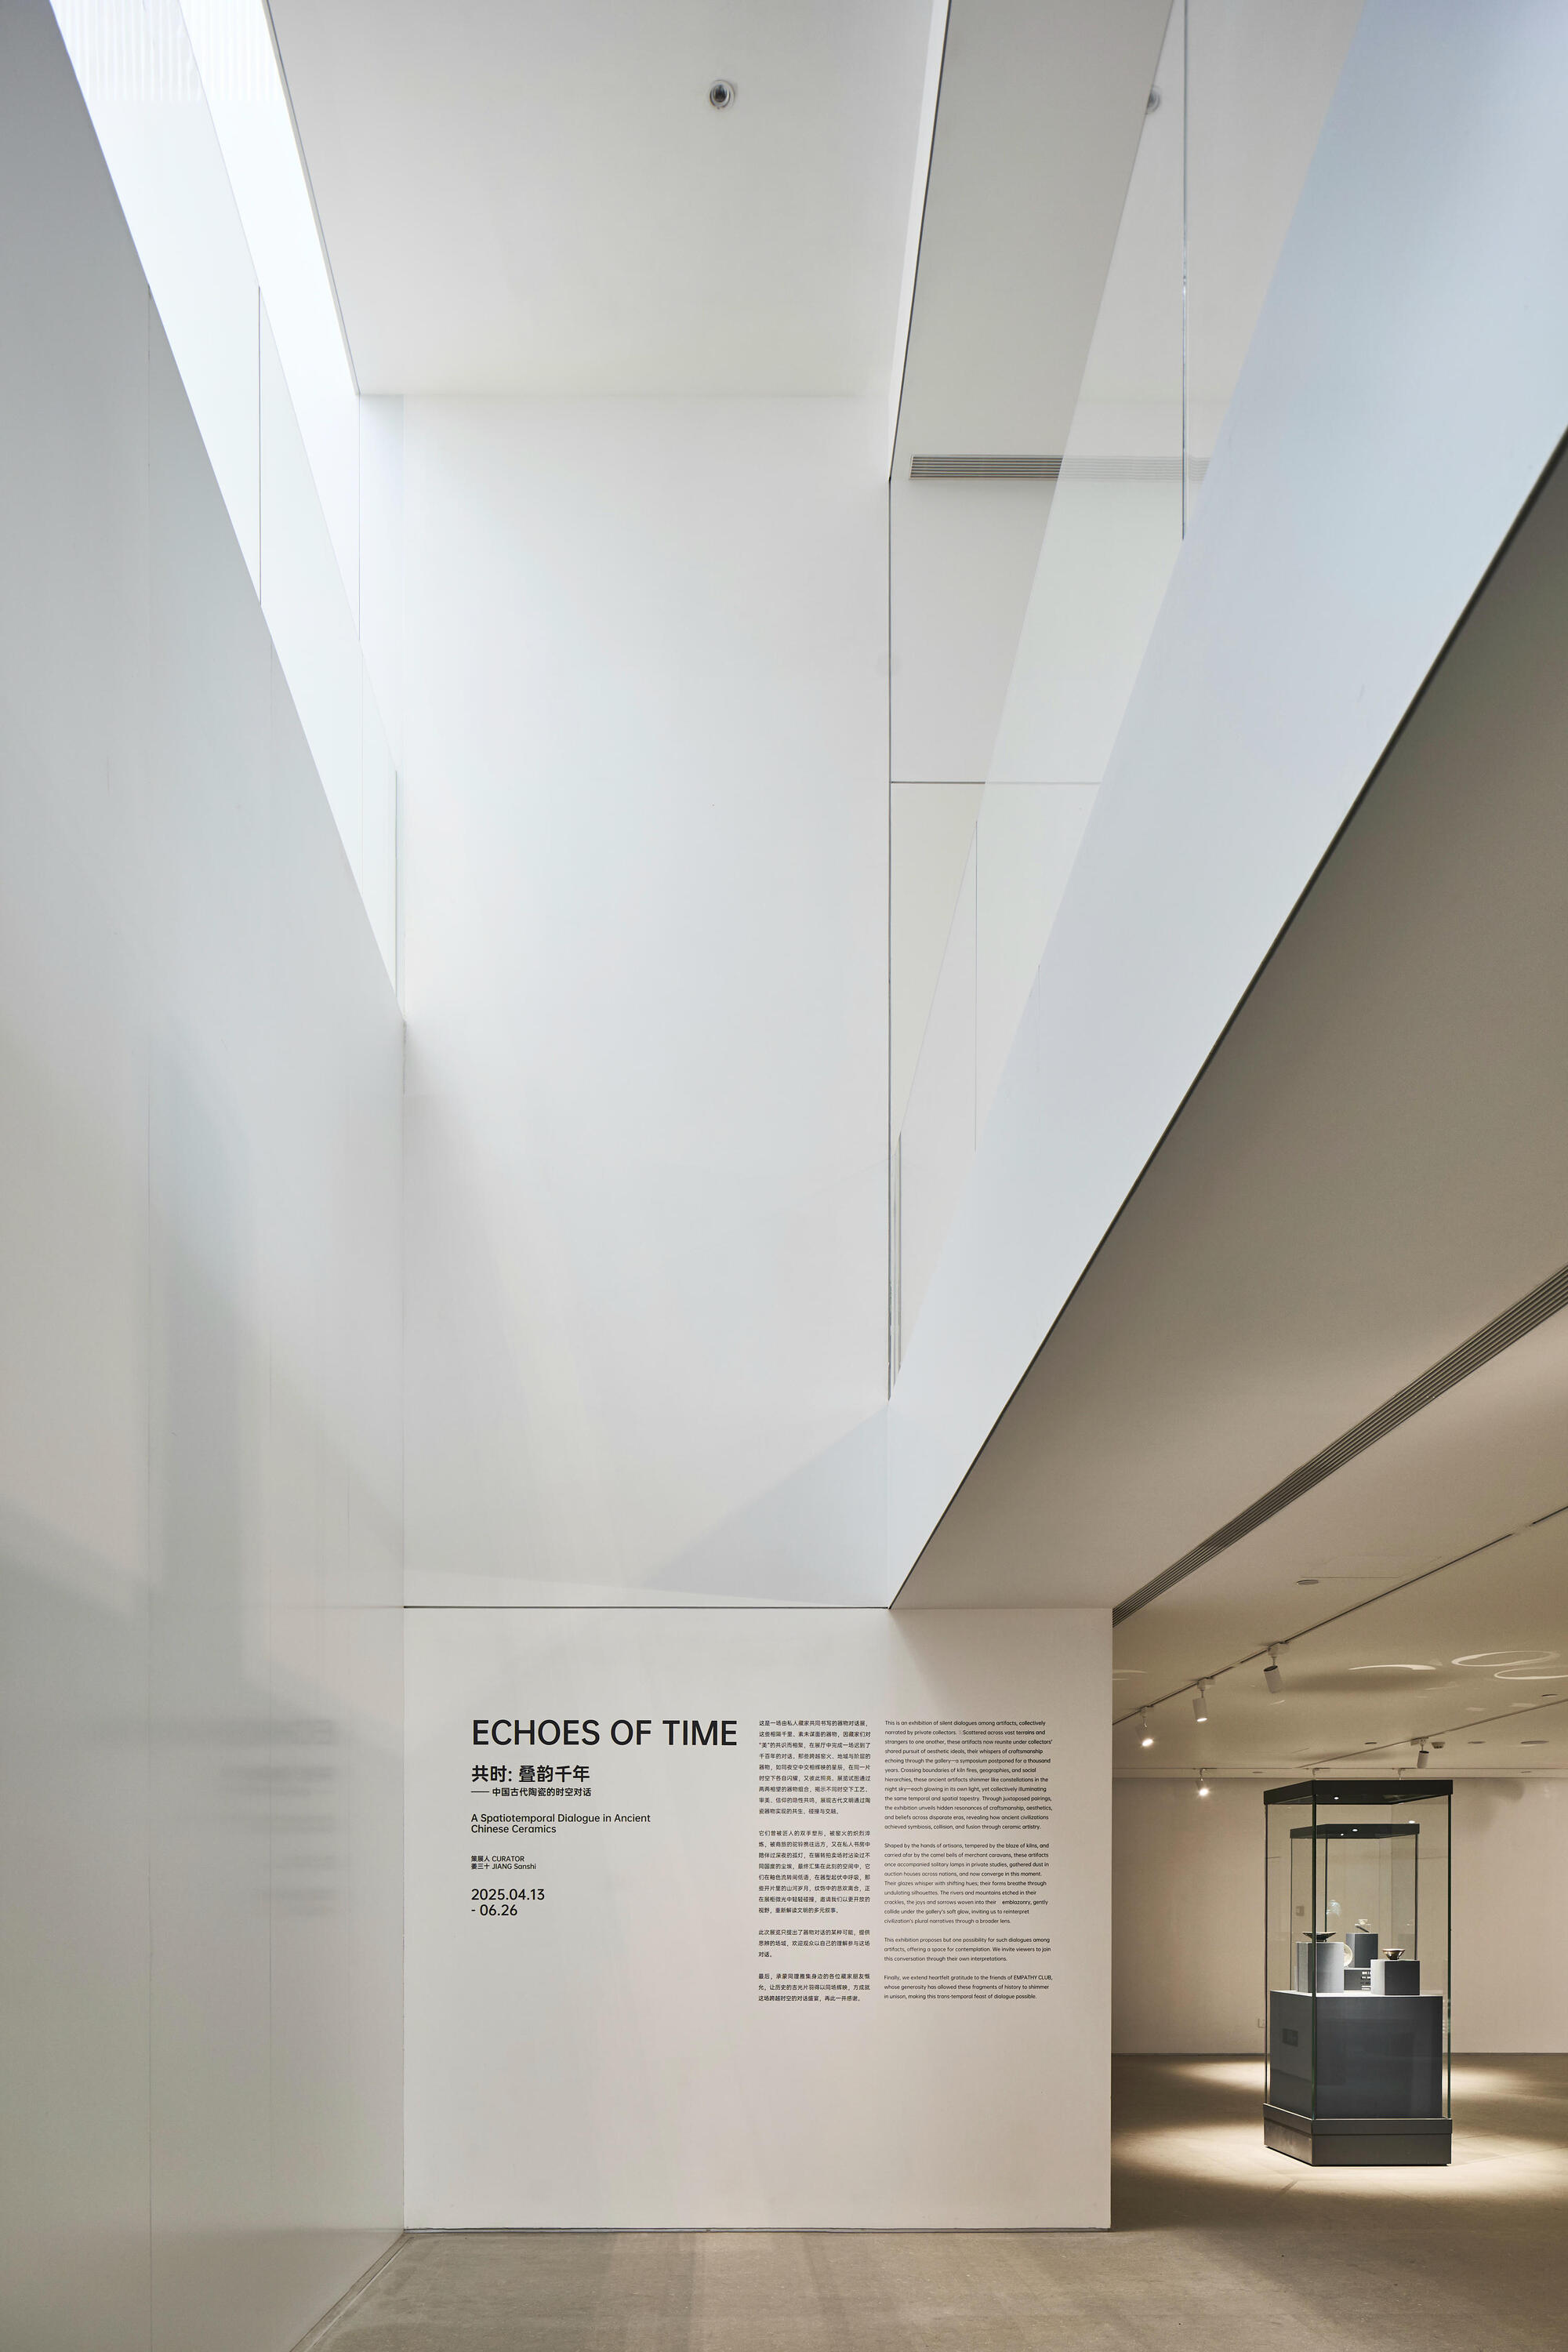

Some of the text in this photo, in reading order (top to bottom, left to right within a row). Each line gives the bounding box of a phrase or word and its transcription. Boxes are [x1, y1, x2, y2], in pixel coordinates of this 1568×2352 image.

[474, 1719, 737, 1745] ECHOES OF TIME
[472, 1765, 590, 1782] 共时: 叠韵千年
[492, 1788, 591, 1796] 中国古代陶瓷的时空对话
[481, 1814, 554, 1824] Spatiotemporal
[558, 1814, 600, 1824] Dialogue
[471, 1824, 509, 1833] Chinese
[472, 1889, 544, 1900] 2025.04.13
[480, 1904, 517, 1915] 06.26
